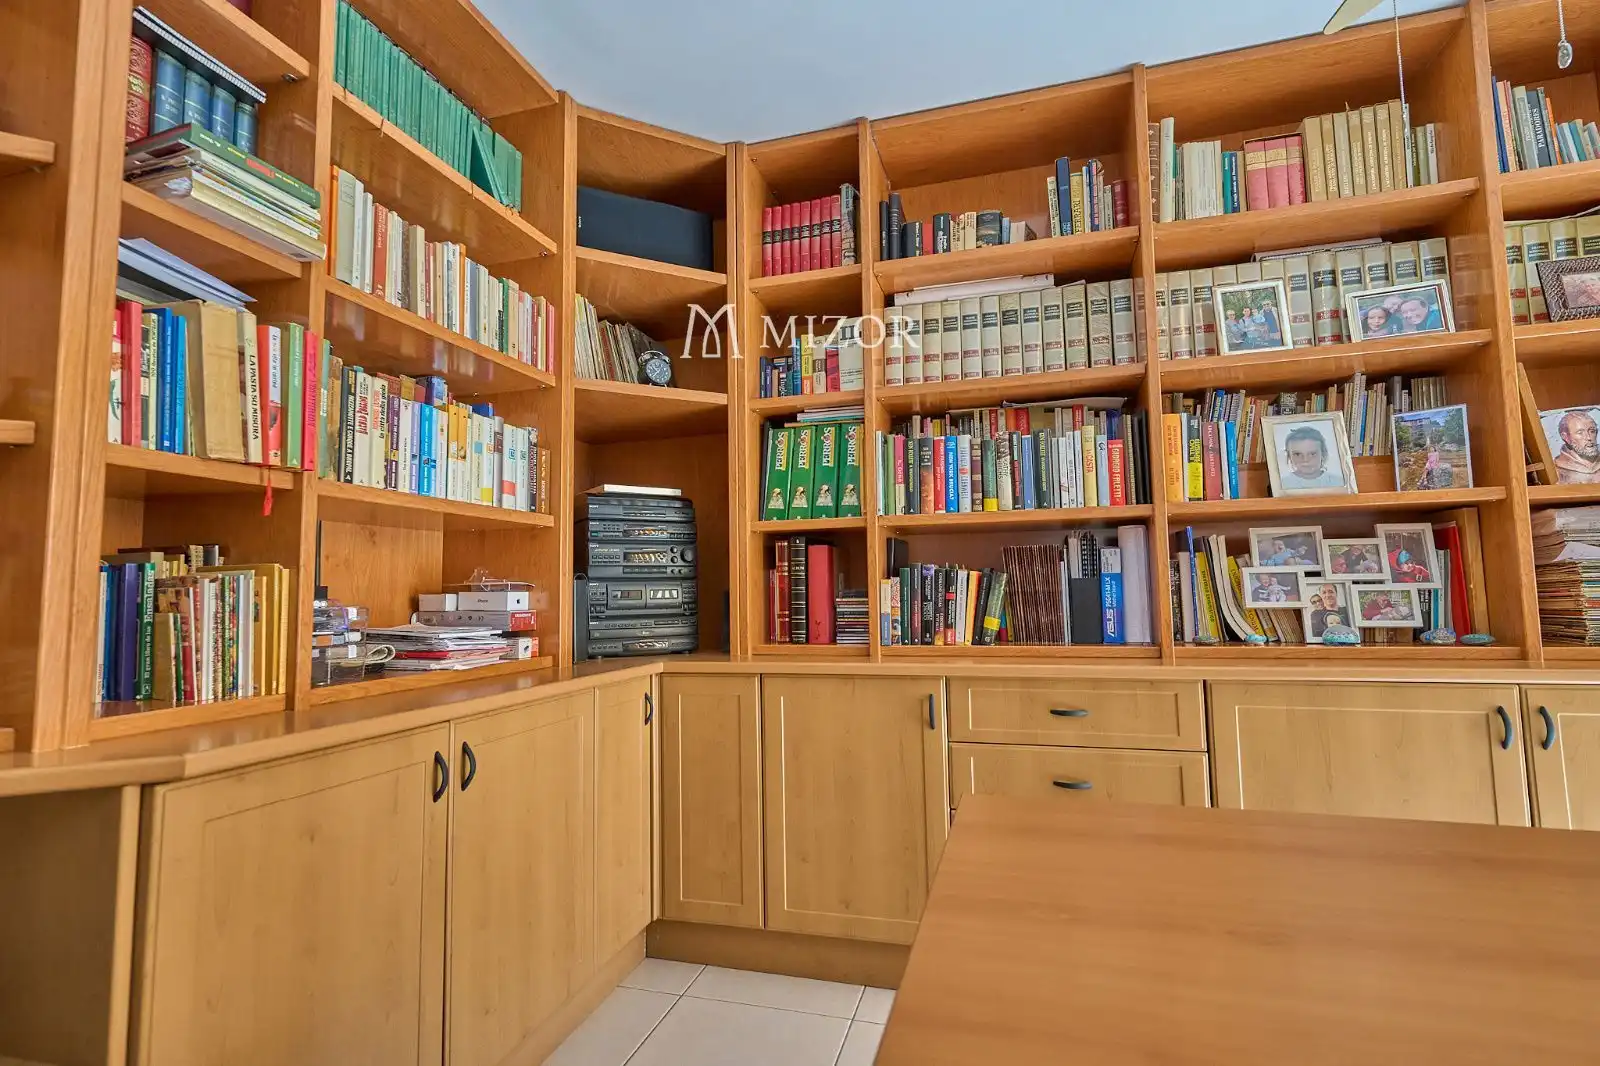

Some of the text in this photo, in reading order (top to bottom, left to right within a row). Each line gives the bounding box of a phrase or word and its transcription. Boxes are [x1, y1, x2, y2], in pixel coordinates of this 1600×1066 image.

[1532, 108, 1545, 147] PARADORES
[249, 354, 256, 364] LA
[249, 365, 258, 393] PASTA
[251, 407, 259, 440] MISURA
[775, 432, 788, 470] PERROS
[798, 430, 809, 469] PERROS
[822, 427, 833, 467] PERROS
[848, 426, 858, 466] PERROS
[1106, 608, 1115, 637] ASUS
